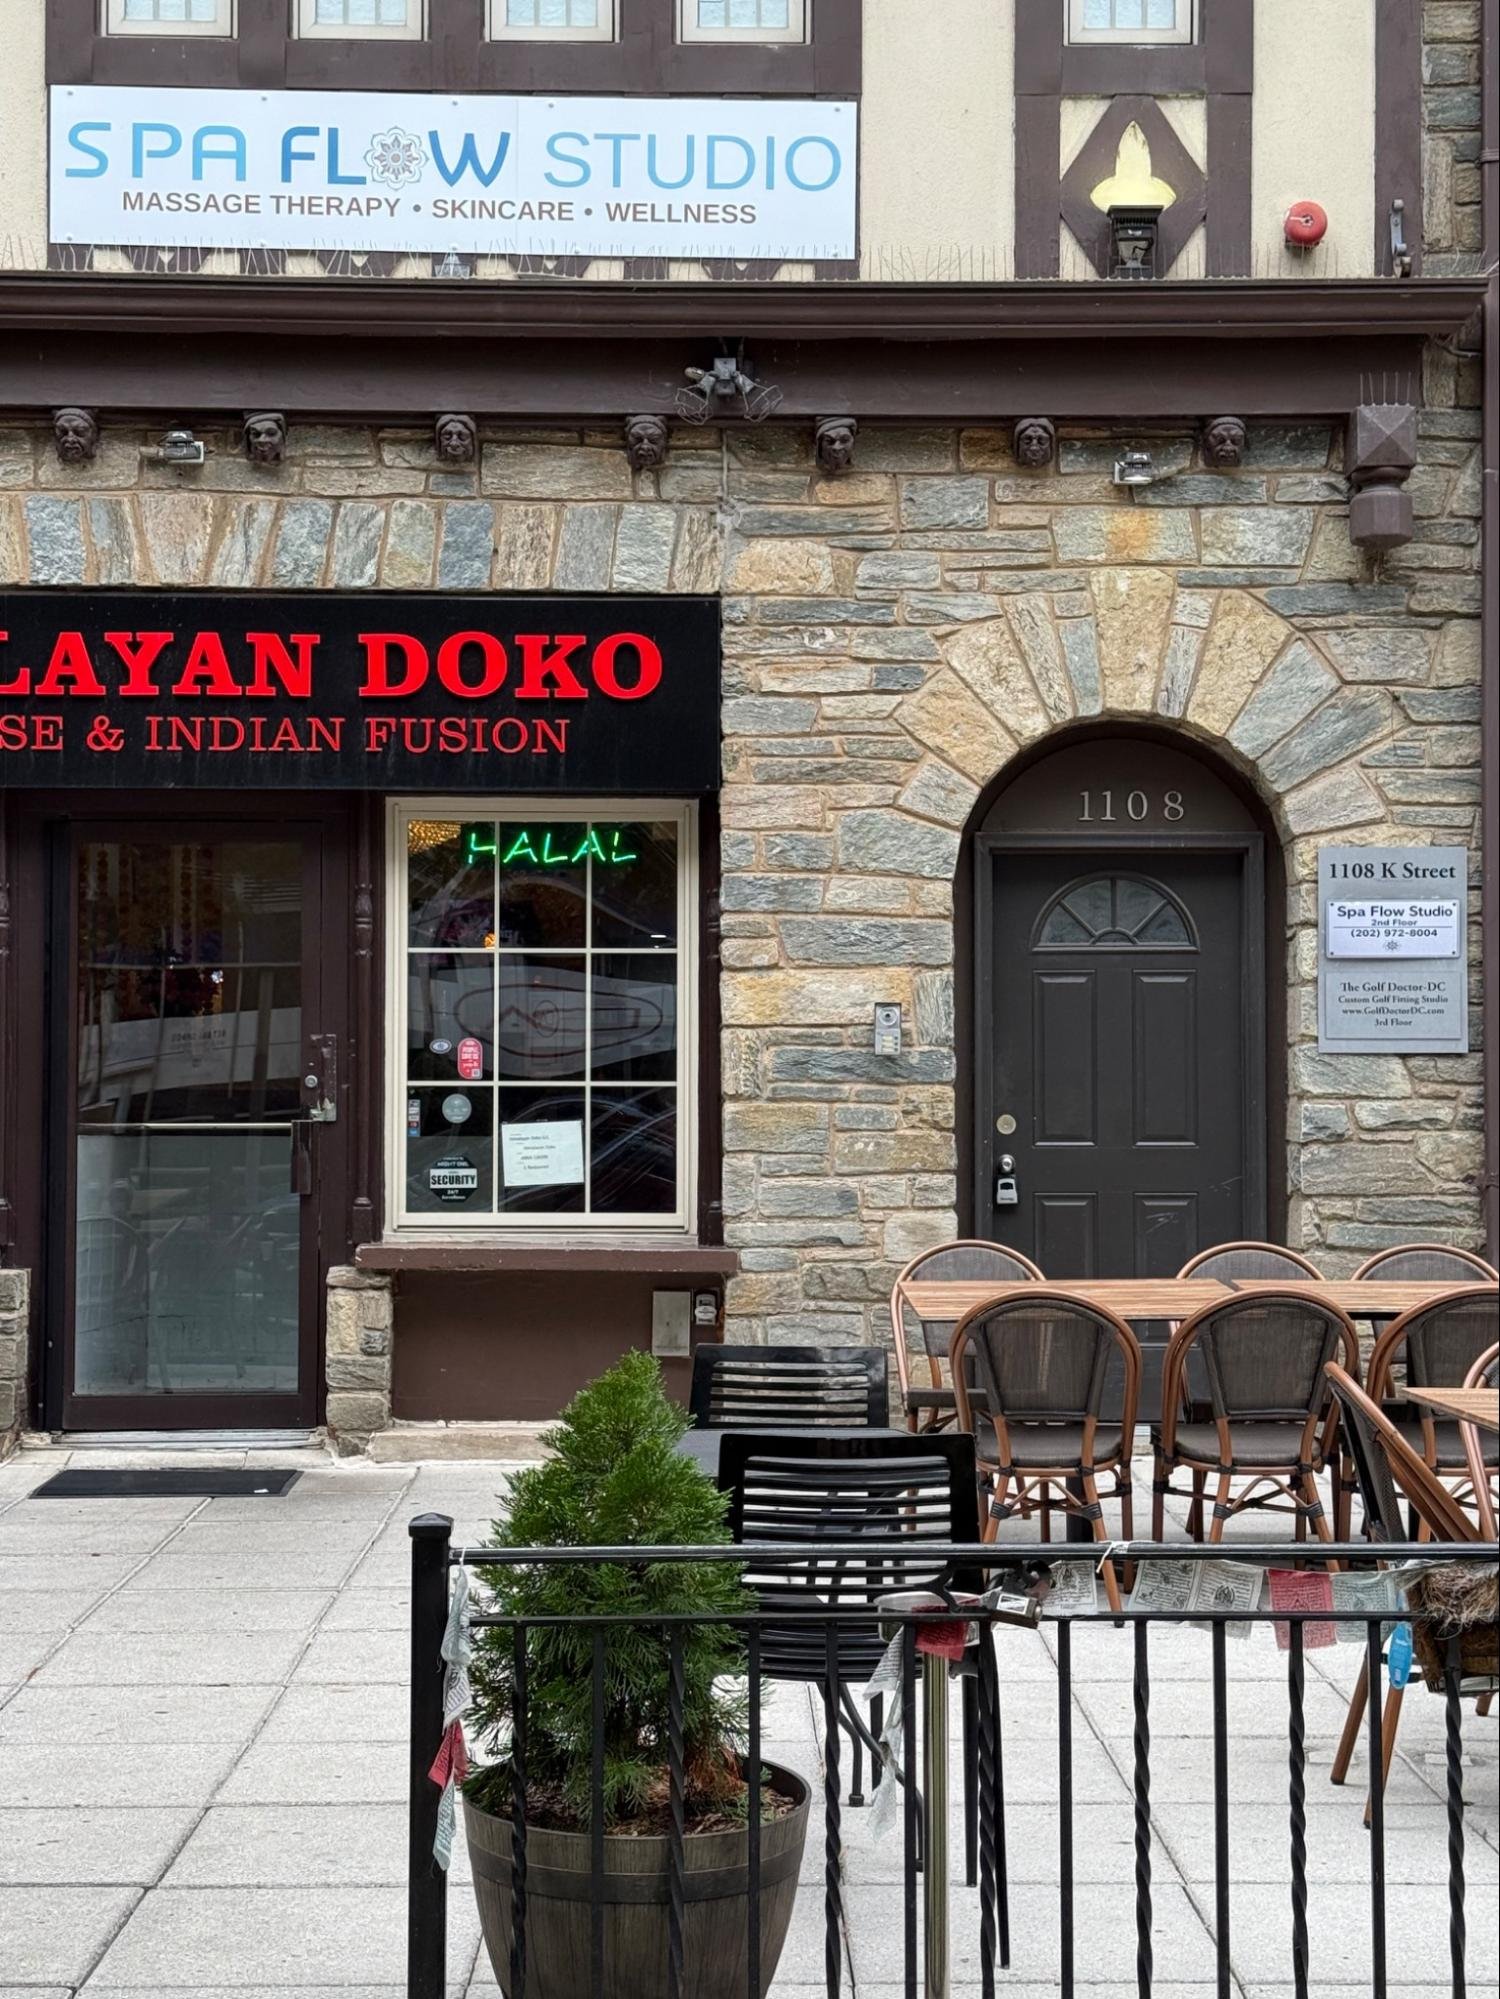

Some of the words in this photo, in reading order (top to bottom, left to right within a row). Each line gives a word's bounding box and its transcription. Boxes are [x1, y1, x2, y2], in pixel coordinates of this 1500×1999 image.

[65, 122, 246, 181] SPA
[544, 131, 842, 192] STUDIO
[122, 191, 261, 214] MASSAGE
[269, 195, 401, 217] THERAPY
[432, 198, 574, 221] SKINCARE
[605, 202, 757, 224] WELLNESS
[358, 632, 663, 699] DOKO
[86, 715, 125, 751] &
[144, 716, 346, 753] INDIAN
[365, 719, 570, 754] FUSION
[1078, 790, 1185, 821] 1108
[468, 830, 637, 865] HALAL
[1329, 863, 1374, 879] 1108
[1381, 862, 1397, 878] K
[1402, 862, 1456, 879] Street
[1337, 906, 1366, 919] Spa
[1370, 905, 1405, 917] Flow
[1409, 905, 1453, 917] Studio
[1371, 919, 1389, 927] 2nd
[1392, 919, 1417, 927] Floor
[1350, 929, 1380, 938] (202)
[1384, 928, 1438, 938] 972-8004
[1340, 982, 1360, 992] The
[1362, 982, 1387, 992] Golf
[1338, 995, 1370, 1004] Custom
[1372, 995, 1391, 1004] Golf
[1392, 995, 1420, 1005] Fitting
[1421, 995, 1448, 1004] Studio
[1342, 1006, 1445, 1015] www.GolfDoctorDC.com
[1375, 1018, 1388, 1026] 3rd
[1391, 1018, 1412, 1026] Floor
[431, 1174, 475, 1186] SECURITY
